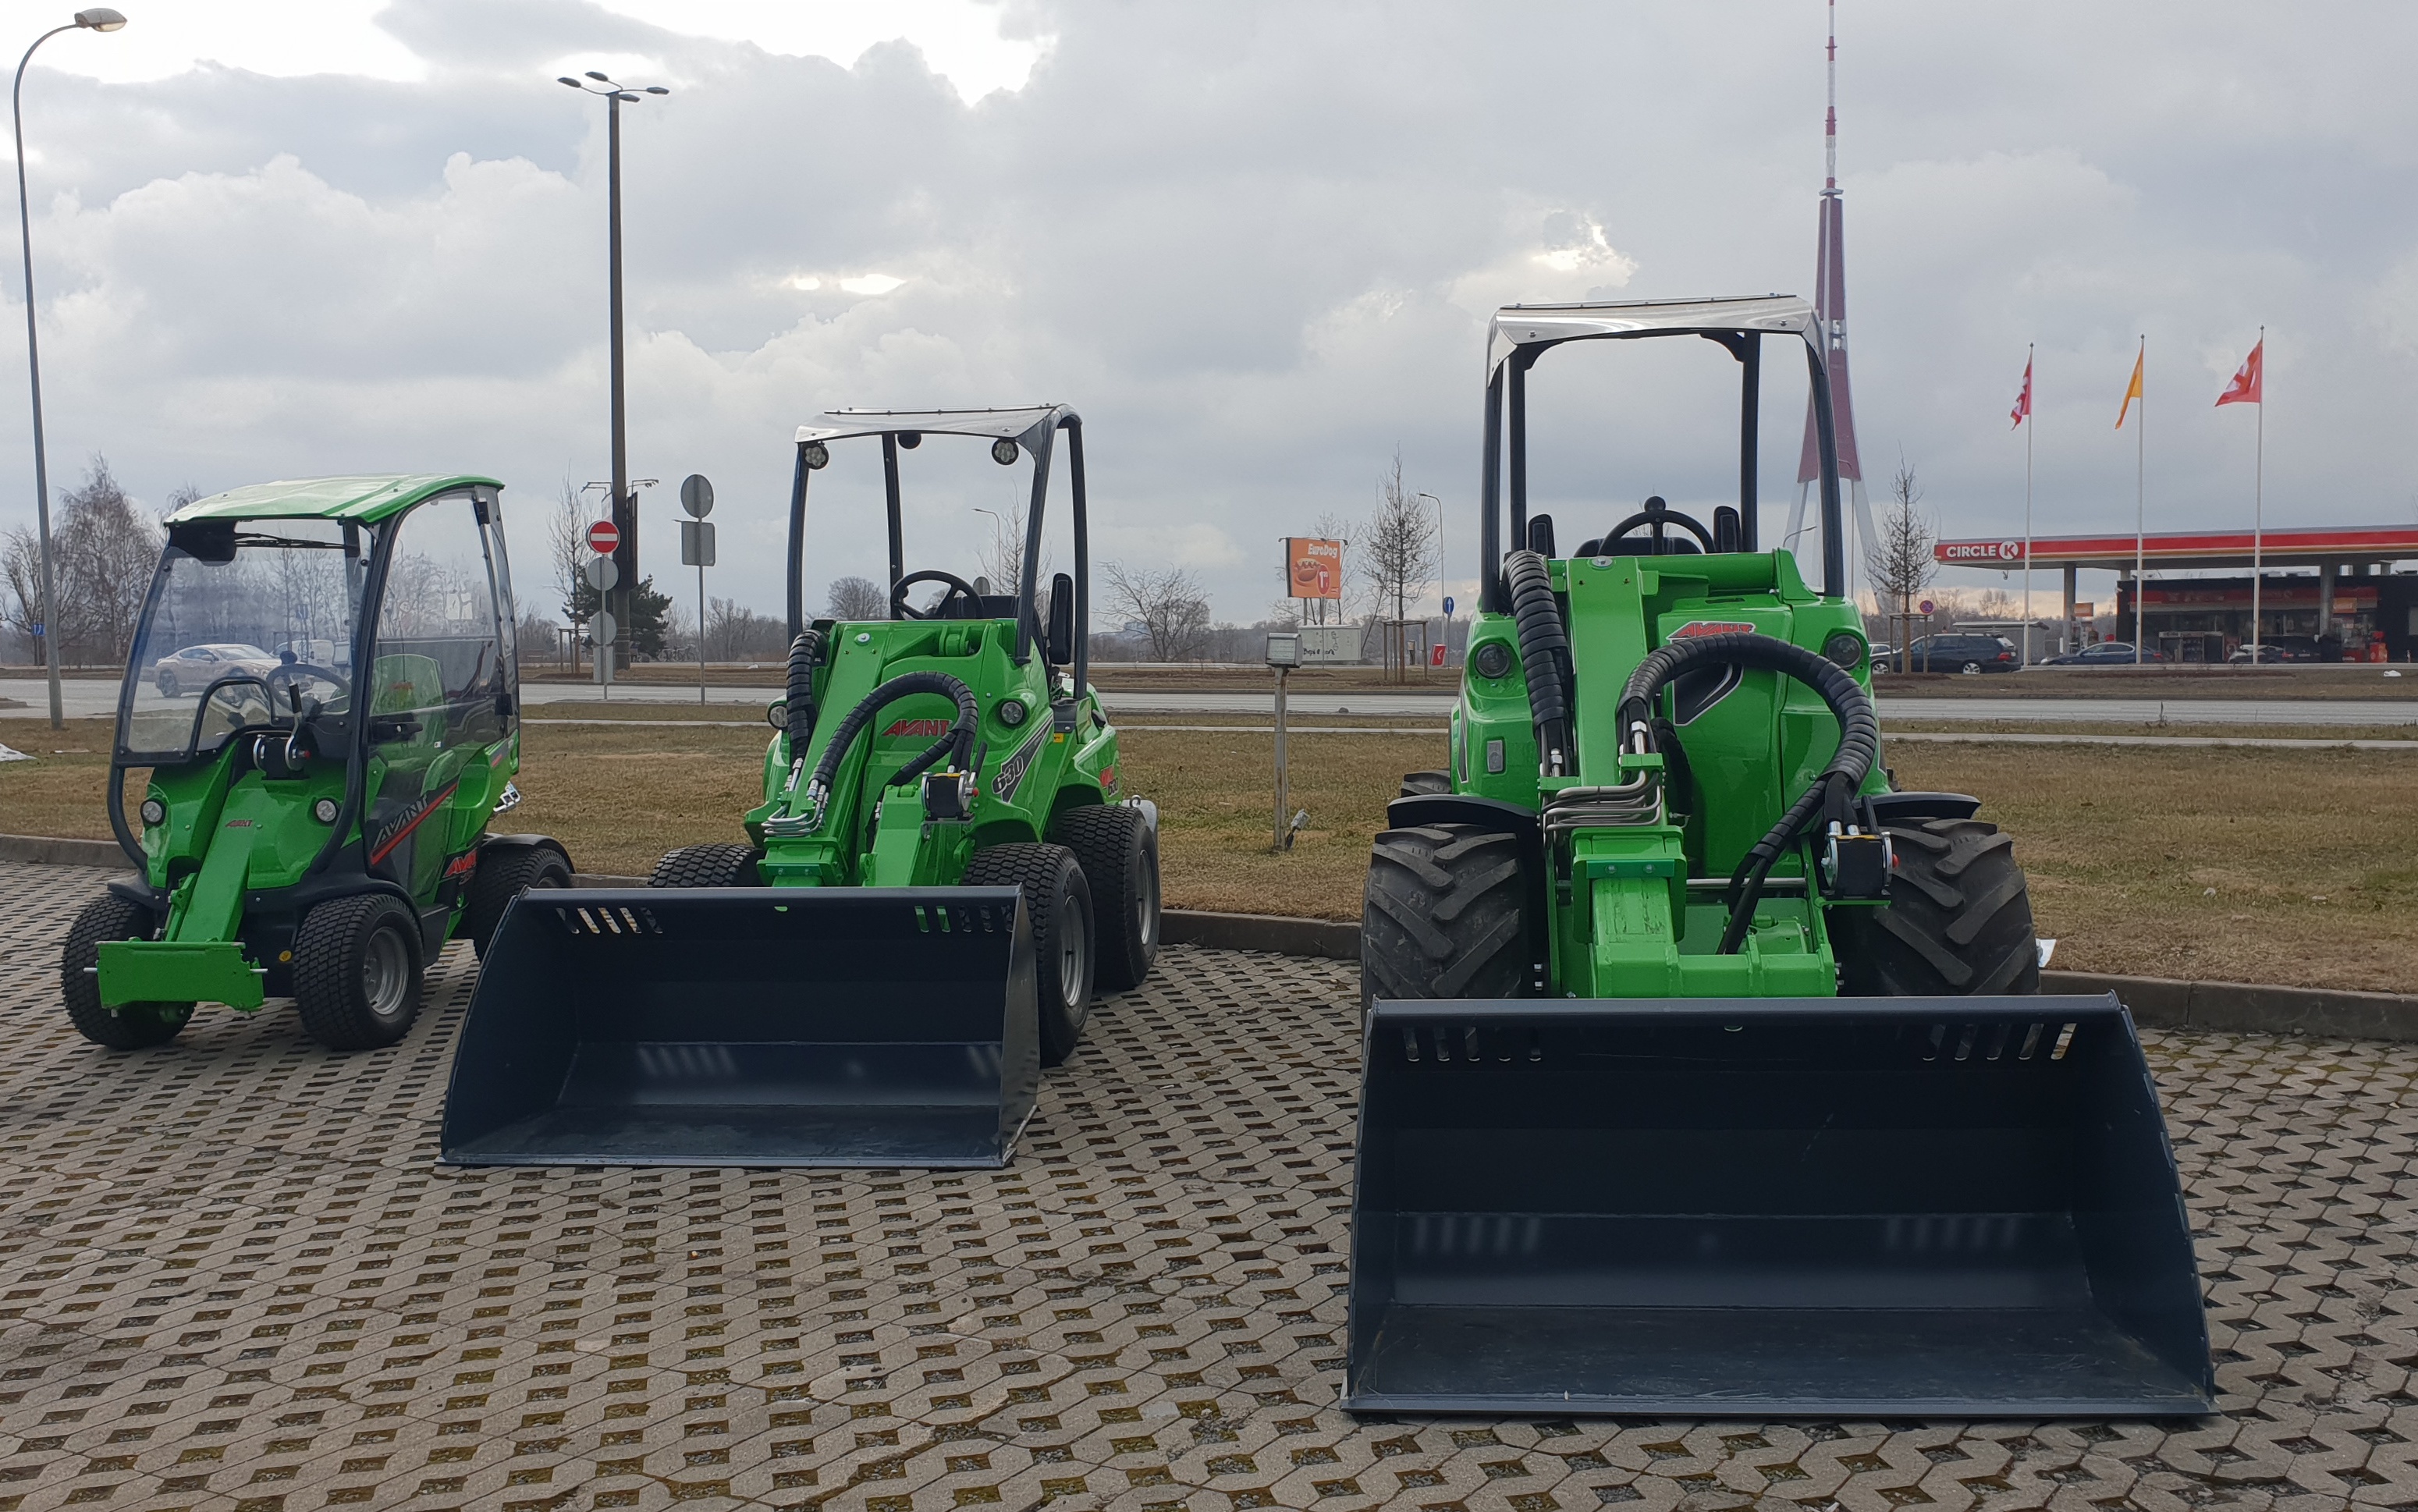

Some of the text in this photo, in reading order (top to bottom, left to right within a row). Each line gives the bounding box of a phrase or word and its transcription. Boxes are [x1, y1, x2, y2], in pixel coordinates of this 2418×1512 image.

[1308, 544, 1337, 559] EuroDog
[1947, 543, 2018, 559] CIRCLE K
[882, 719, 952, 736] AVANT
[992, 756, 1024, 794] 630
[374, 794, 428, 849] AVANT
